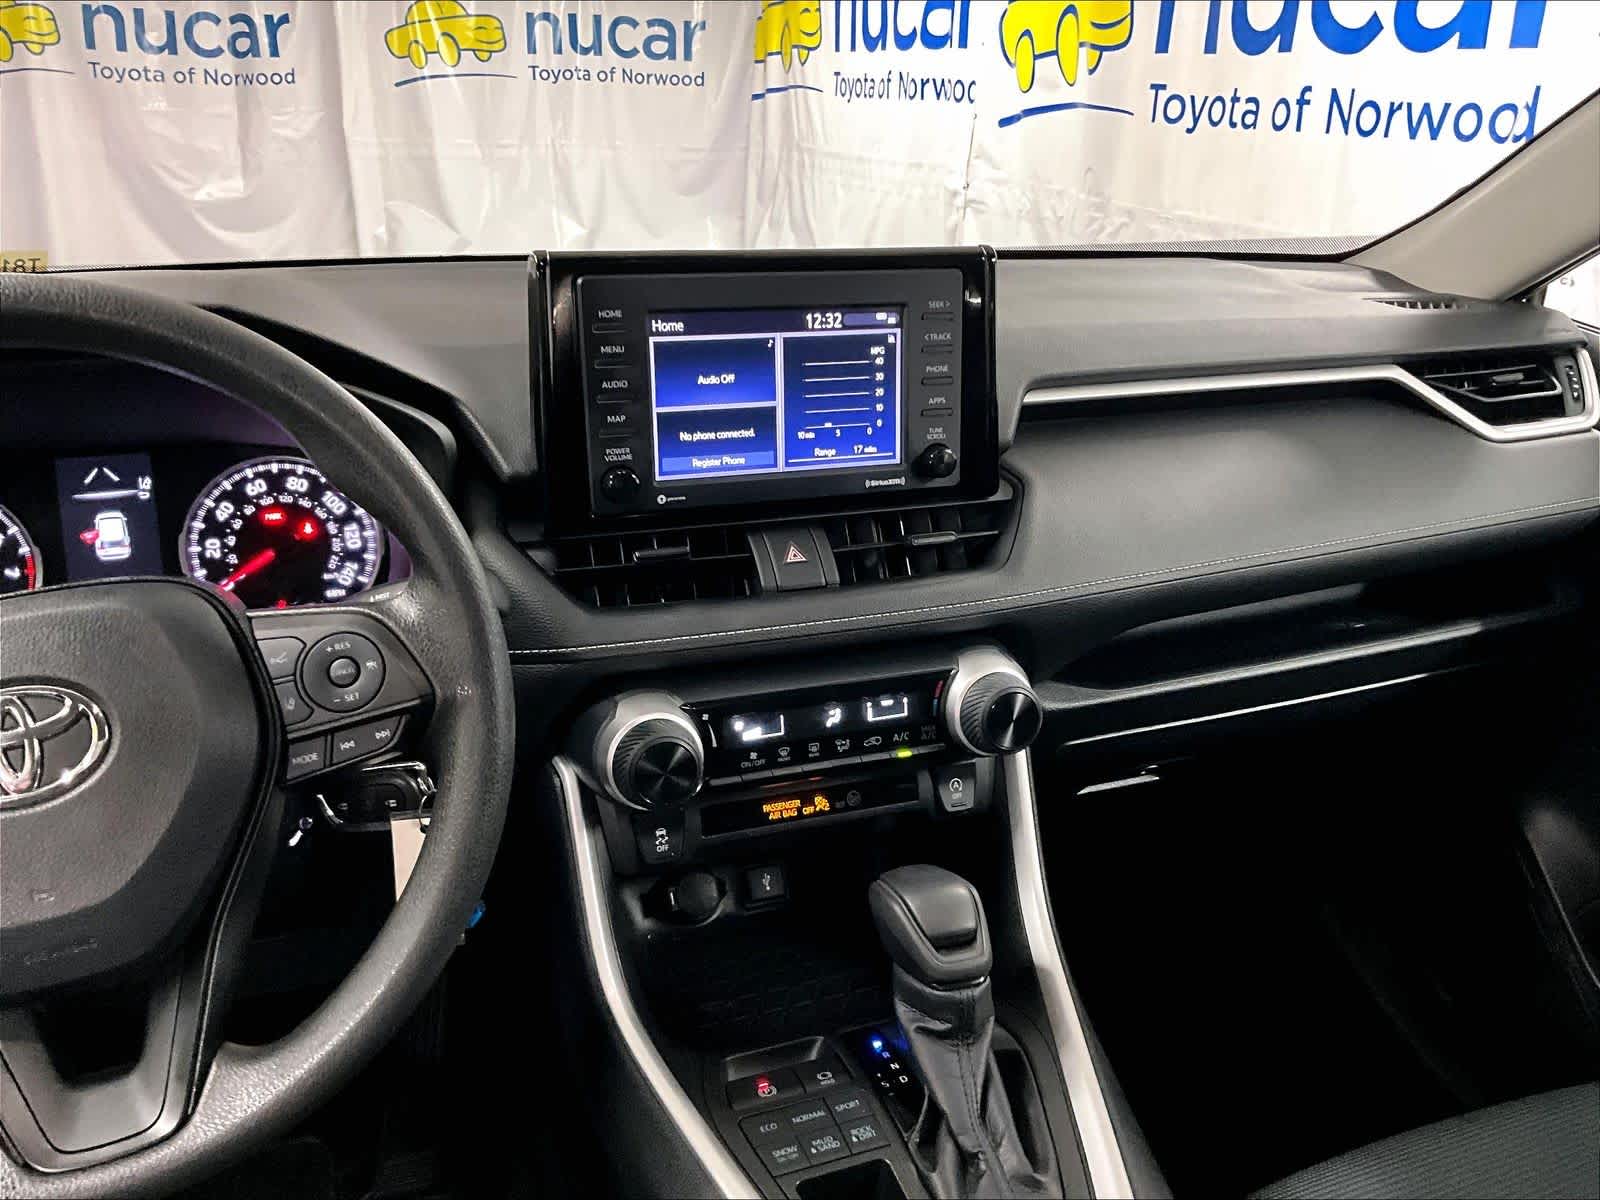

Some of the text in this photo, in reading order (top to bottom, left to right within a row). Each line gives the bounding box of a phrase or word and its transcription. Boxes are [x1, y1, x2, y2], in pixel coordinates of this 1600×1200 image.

[82, 2, 290, 59] nucar
[525, 11, 707, 62] nucar
[88, 61, 296, 86] Toyota of Norwood
[528, 65, 705, 88] Toyota of Norwood
[834, 71, 875, 103] Toyota
[878, 70, 892, 99] of
[1149, 83, 1542, 144] Toyota of Norwood
[598, 310, 623, 319] HOME
[805, 312, 843, 329] 12:32
[651, 319, 685, 333] Home
[600, 345, 625, 354] MENU
[870, 346, 886, 356] MPG
[874, 357, 885, 366] 40
[698, 373, 736, 385] Audio Off
[875, 373, 885, 382] 30
[602, 380, 628, 389] AUDIO
[874, 388, 885, 397] 20
[875, 403, 884, 413] 10
[607, 415, 627, 424] MAP
[876, 419, 883, 428] 0
[680, 428, 756, 442] No phone connected.
[798, 431, 806, 440] 10
[866, 427, 873, 436] 0
[606, 447, 631, 455] POWER
[814, 447, 837, 458] Range
[853, 444, 864, 454] 17
[604, 454, 633, 463] VOLUME
[692, 455, 746, 468] Register Phone
[245, 478, 268, 496] 60
[285, 476, 310, 493] 80
[321, 490, 348, 516] 100
[214, 501, 235, 522] 40
[343, 523, 363, 551] 120
[204, 538, 222, 560] 20
[336, 561, 359, 587] 140
[892, 731, 910, 743] A/C
[292, 752, 319, 765] MODE
[740, 758, 766, 769] ON/OFF
[762, 799, 801, 813] PASSENGER
[802, 805, 815, 815] OFF
[768, 809, 798, 820] AIR BAG
[656, 844, 670, 853] OFF
[834, 1099, 860, 1113] SPORT
[792, 1110, 825, 1125] NORMAL
[759, 1122, 778, 1133] ECO
[771, 1144, 799, 1159] SNOW
